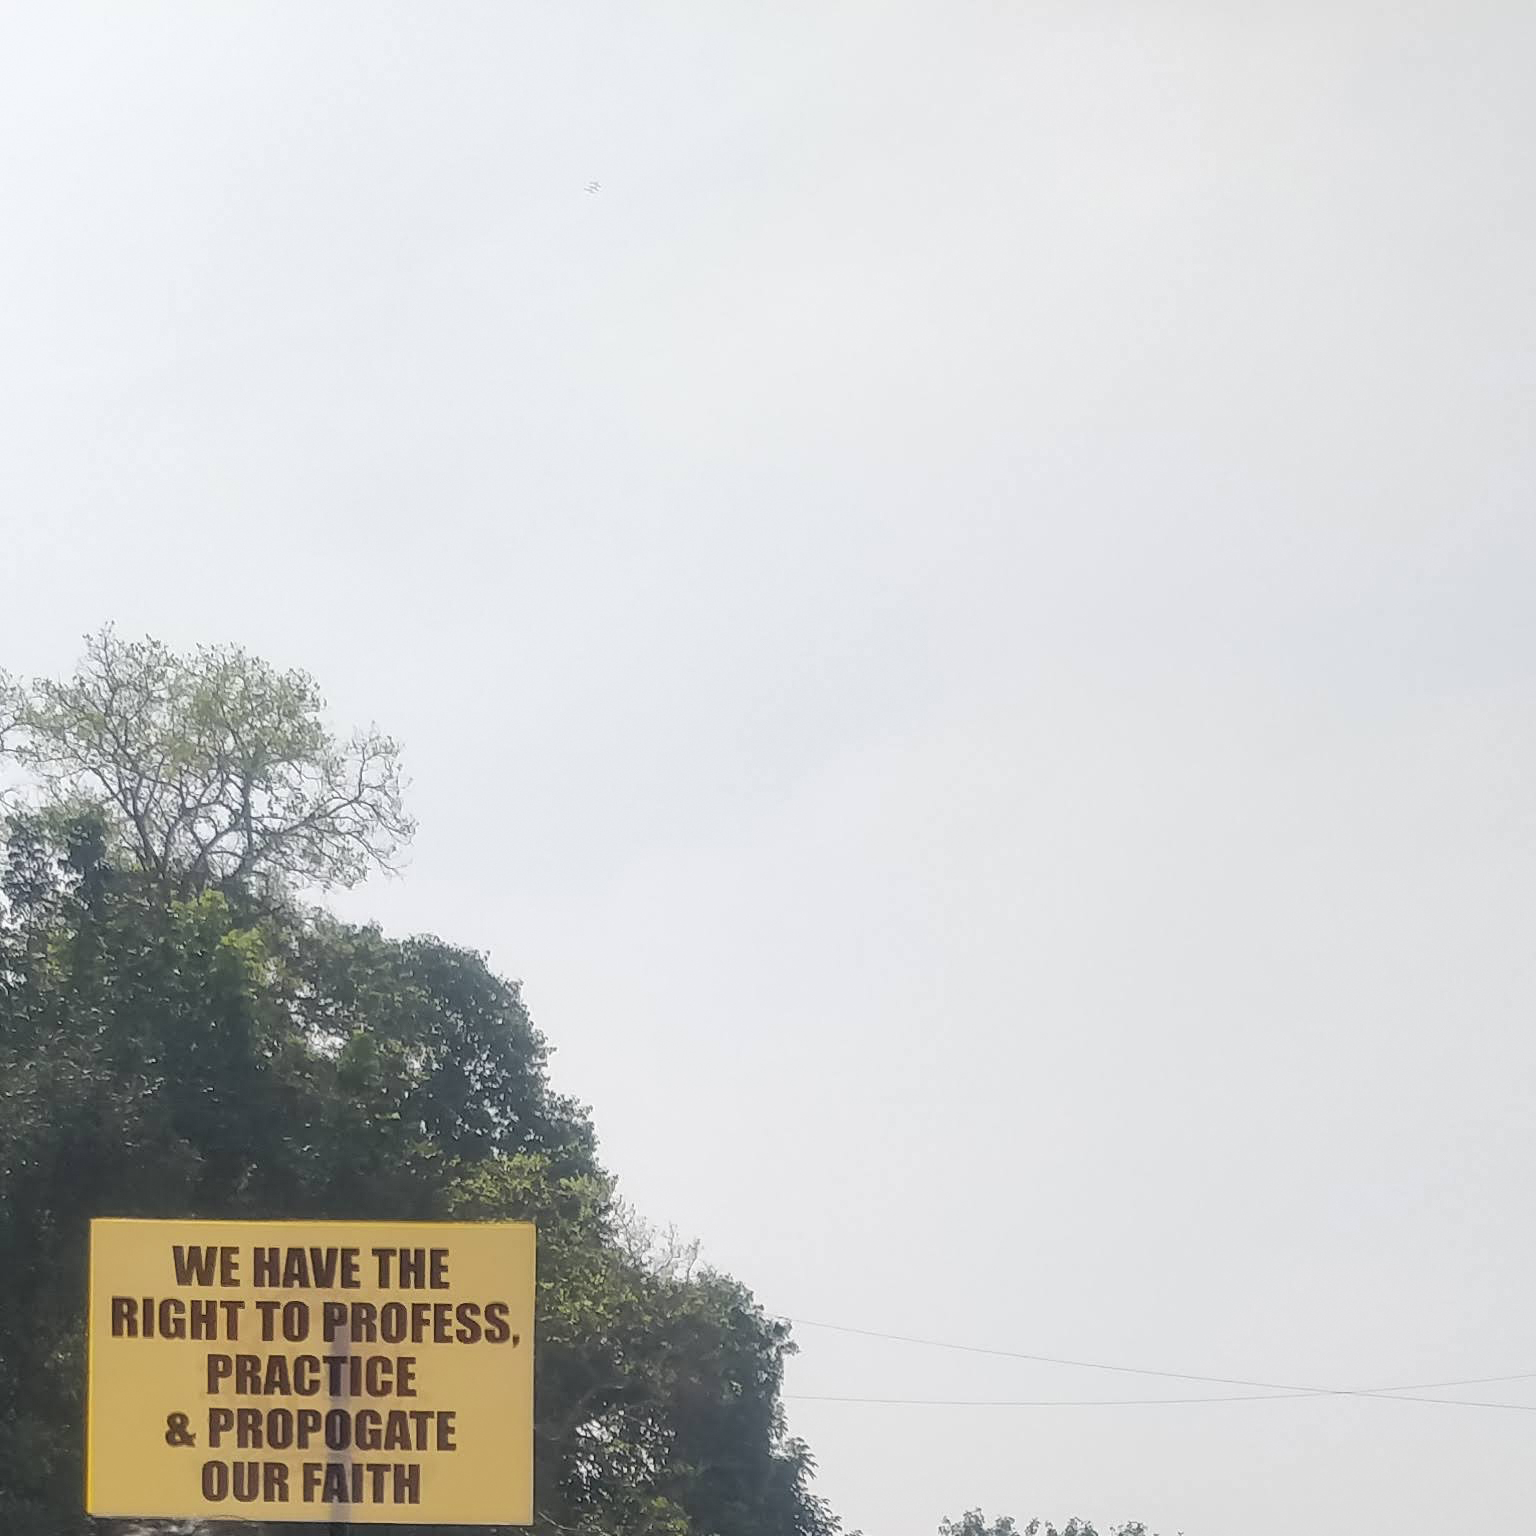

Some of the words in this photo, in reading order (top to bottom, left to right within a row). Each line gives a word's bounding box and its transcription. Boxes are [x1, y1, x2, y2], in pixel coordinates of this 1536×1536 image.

[172, 1245, 242, 1287] WE
[253, 1247, 360, 1289] HAVE
[372, 1247, 450, 1290] THE
[111, 1296, 245, 1341] RIGHT
[256, 1300, 309, 1342] TO
[323, 1301, 521, 1348] PROFESS,
[207, 1354, 417, 1398] PRACTICE
[165, 1412, 196, 1448] &
[208, 1407, 457, 1452] PROPOGATE
[201, 1460, 289, 1503] OUR
[302, 1462, 421, 1505] FAITH
